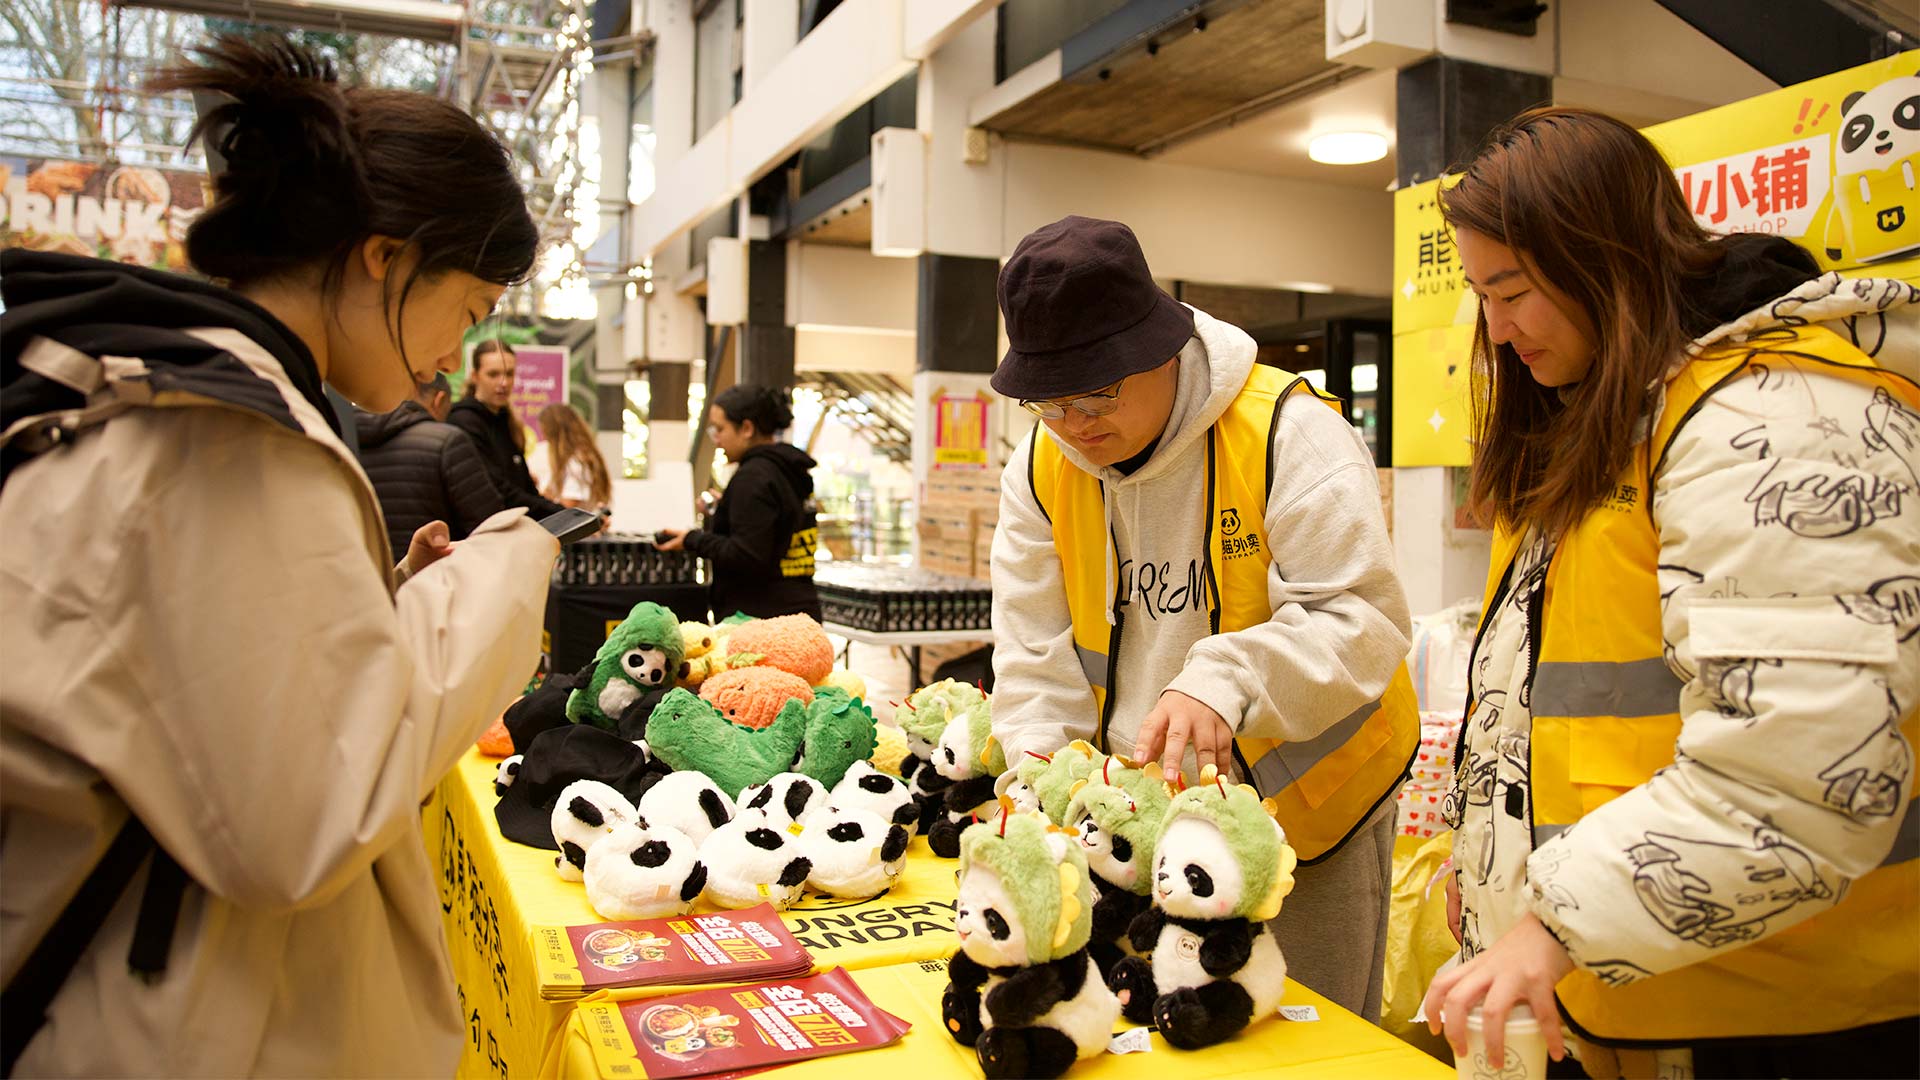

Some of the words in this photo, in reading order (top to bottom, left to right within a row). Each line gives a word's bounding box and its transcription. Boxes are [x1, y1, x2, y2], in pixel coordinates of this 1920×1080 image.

[1678, 147, 1811, 224] 小铺
[0, 191, 168, 242] RINK
[1418, 229, 1464, 279] 熊
[1222, 533, 1260, 554] 猫外卖
[791, 899, 958, 934] UNGRY
[801, 920, 955, 949] ANDA
[760, 984, 850, 1046] 全店7折
